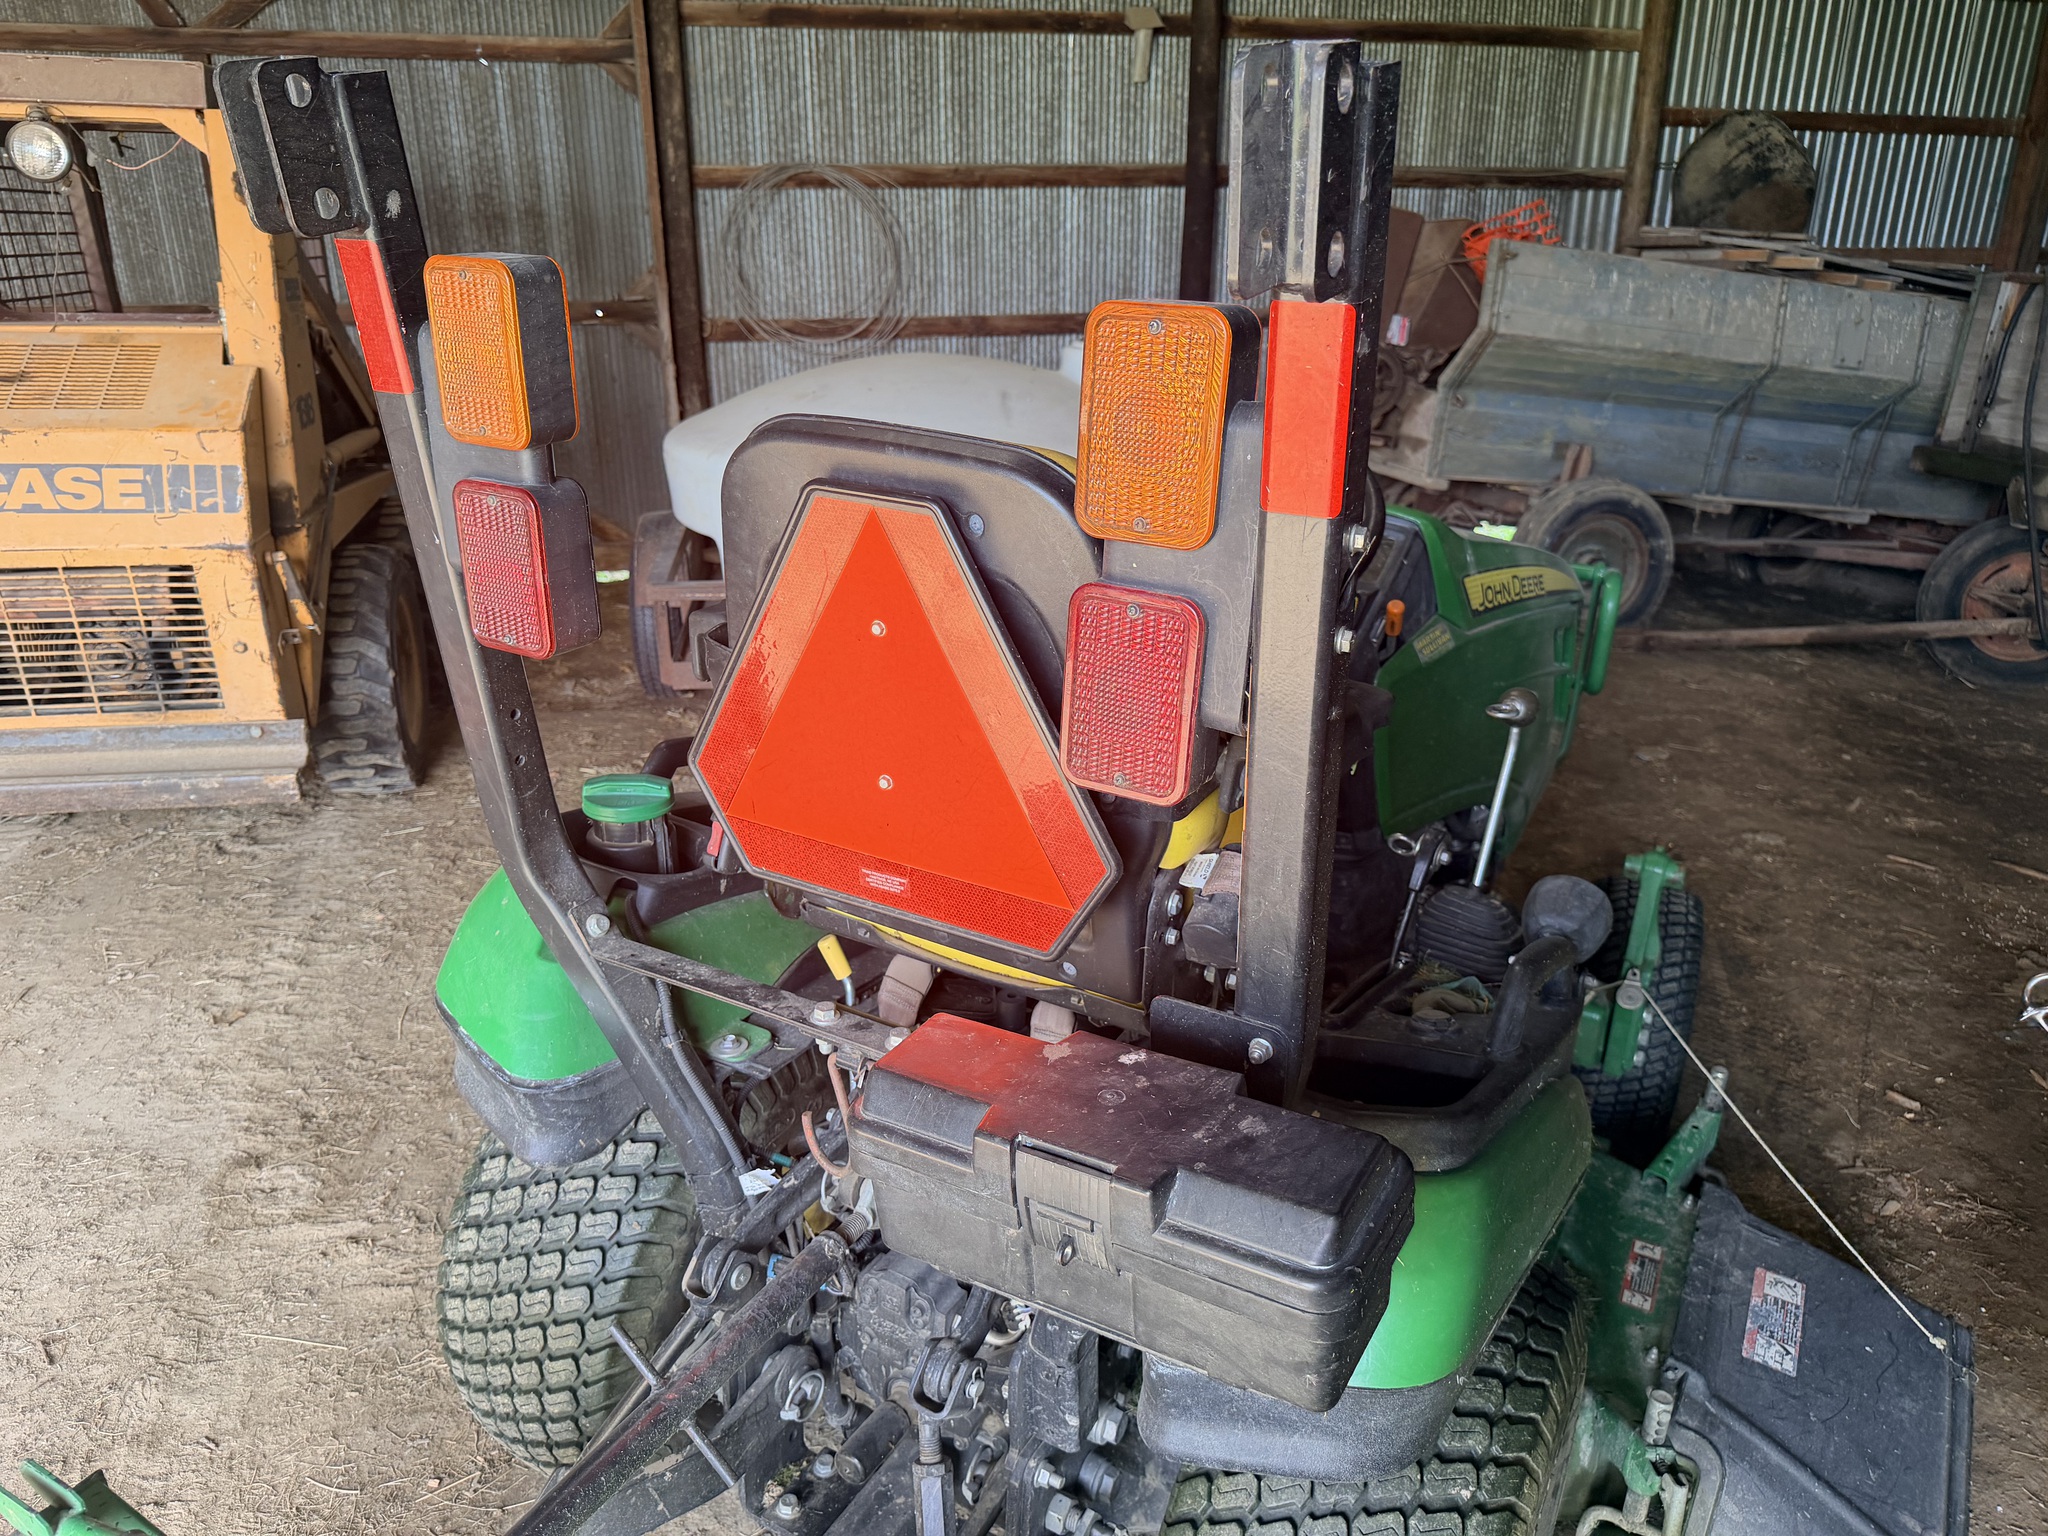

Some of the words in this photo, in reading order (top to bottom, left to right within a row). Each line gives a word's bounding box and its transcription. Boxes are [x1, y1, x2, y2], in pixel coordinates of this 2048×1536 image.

[0, 467, 146, 511] ASE
[1479, 580, 1511, 608] JOHN
[1512, 574, 1545, 598] DEERE
